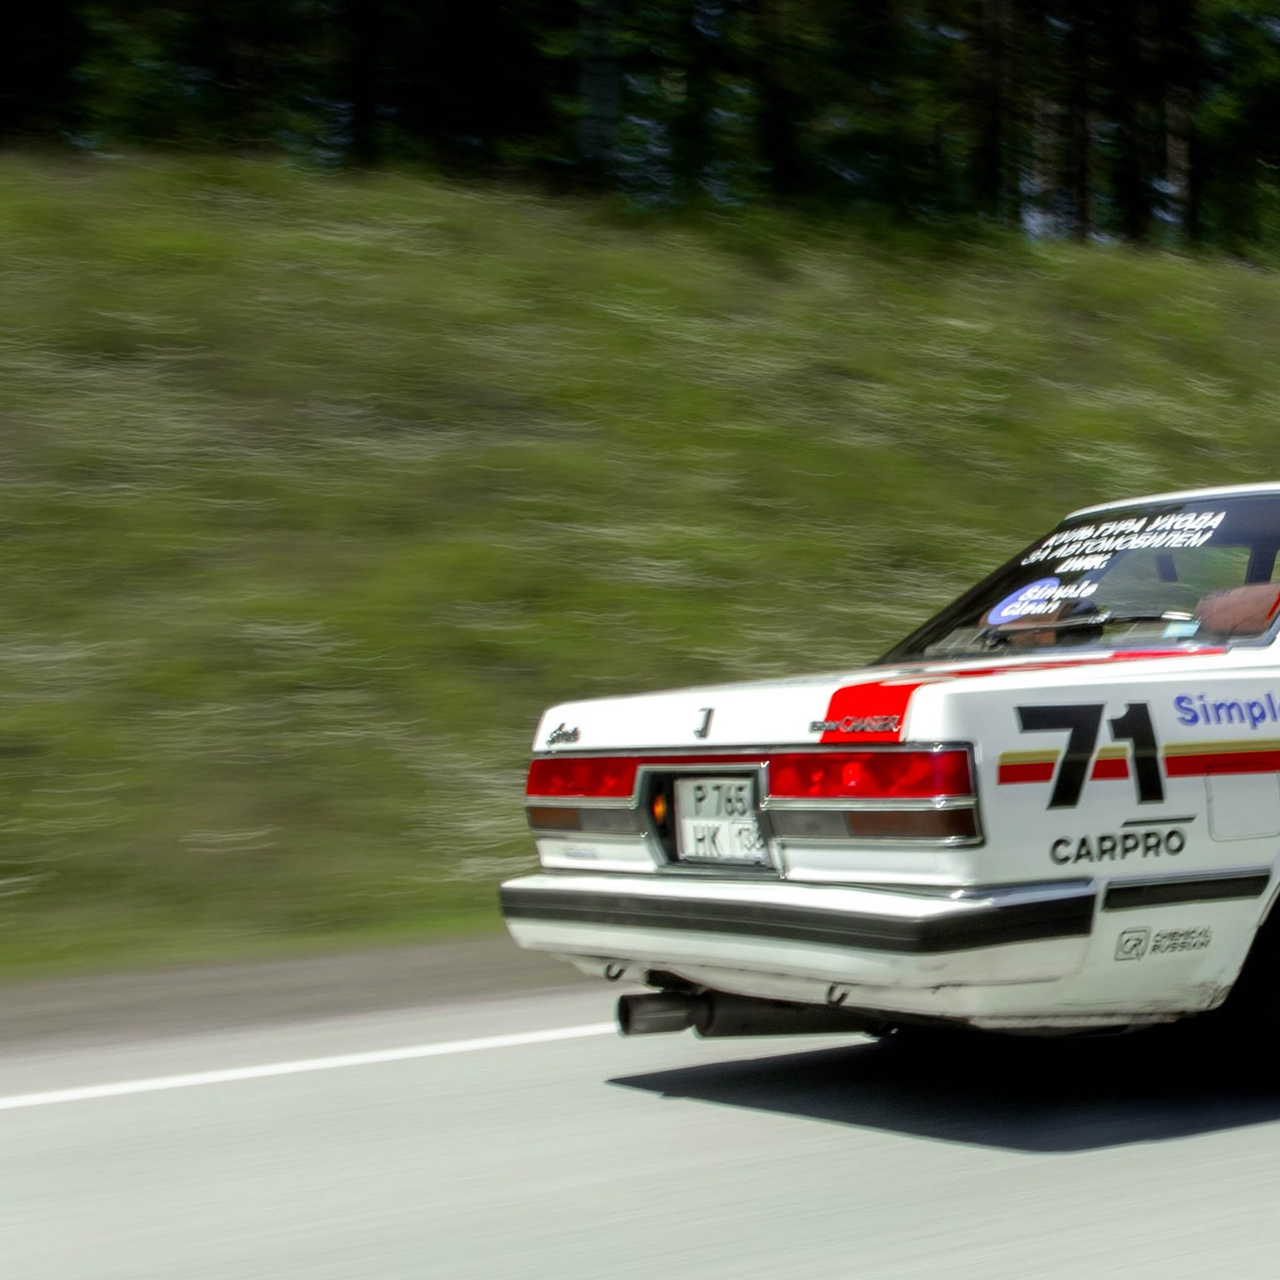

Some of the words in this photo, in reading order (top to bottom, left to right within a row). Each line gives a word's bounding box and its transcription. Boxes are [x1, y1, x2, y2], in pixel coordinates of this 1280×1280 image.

[1042, 517, 1147, 549] КУЛЬТУРА
[1146, 511, 1226, 532] УХОДА
[1048, 530, 1213, 559] АВТОМОБИЛЕМ
[1018, 580, 1098, 601] Simple
[1014, 702, 1165, 810] 71
[1050, 829, 1187, 865] CARPRO
